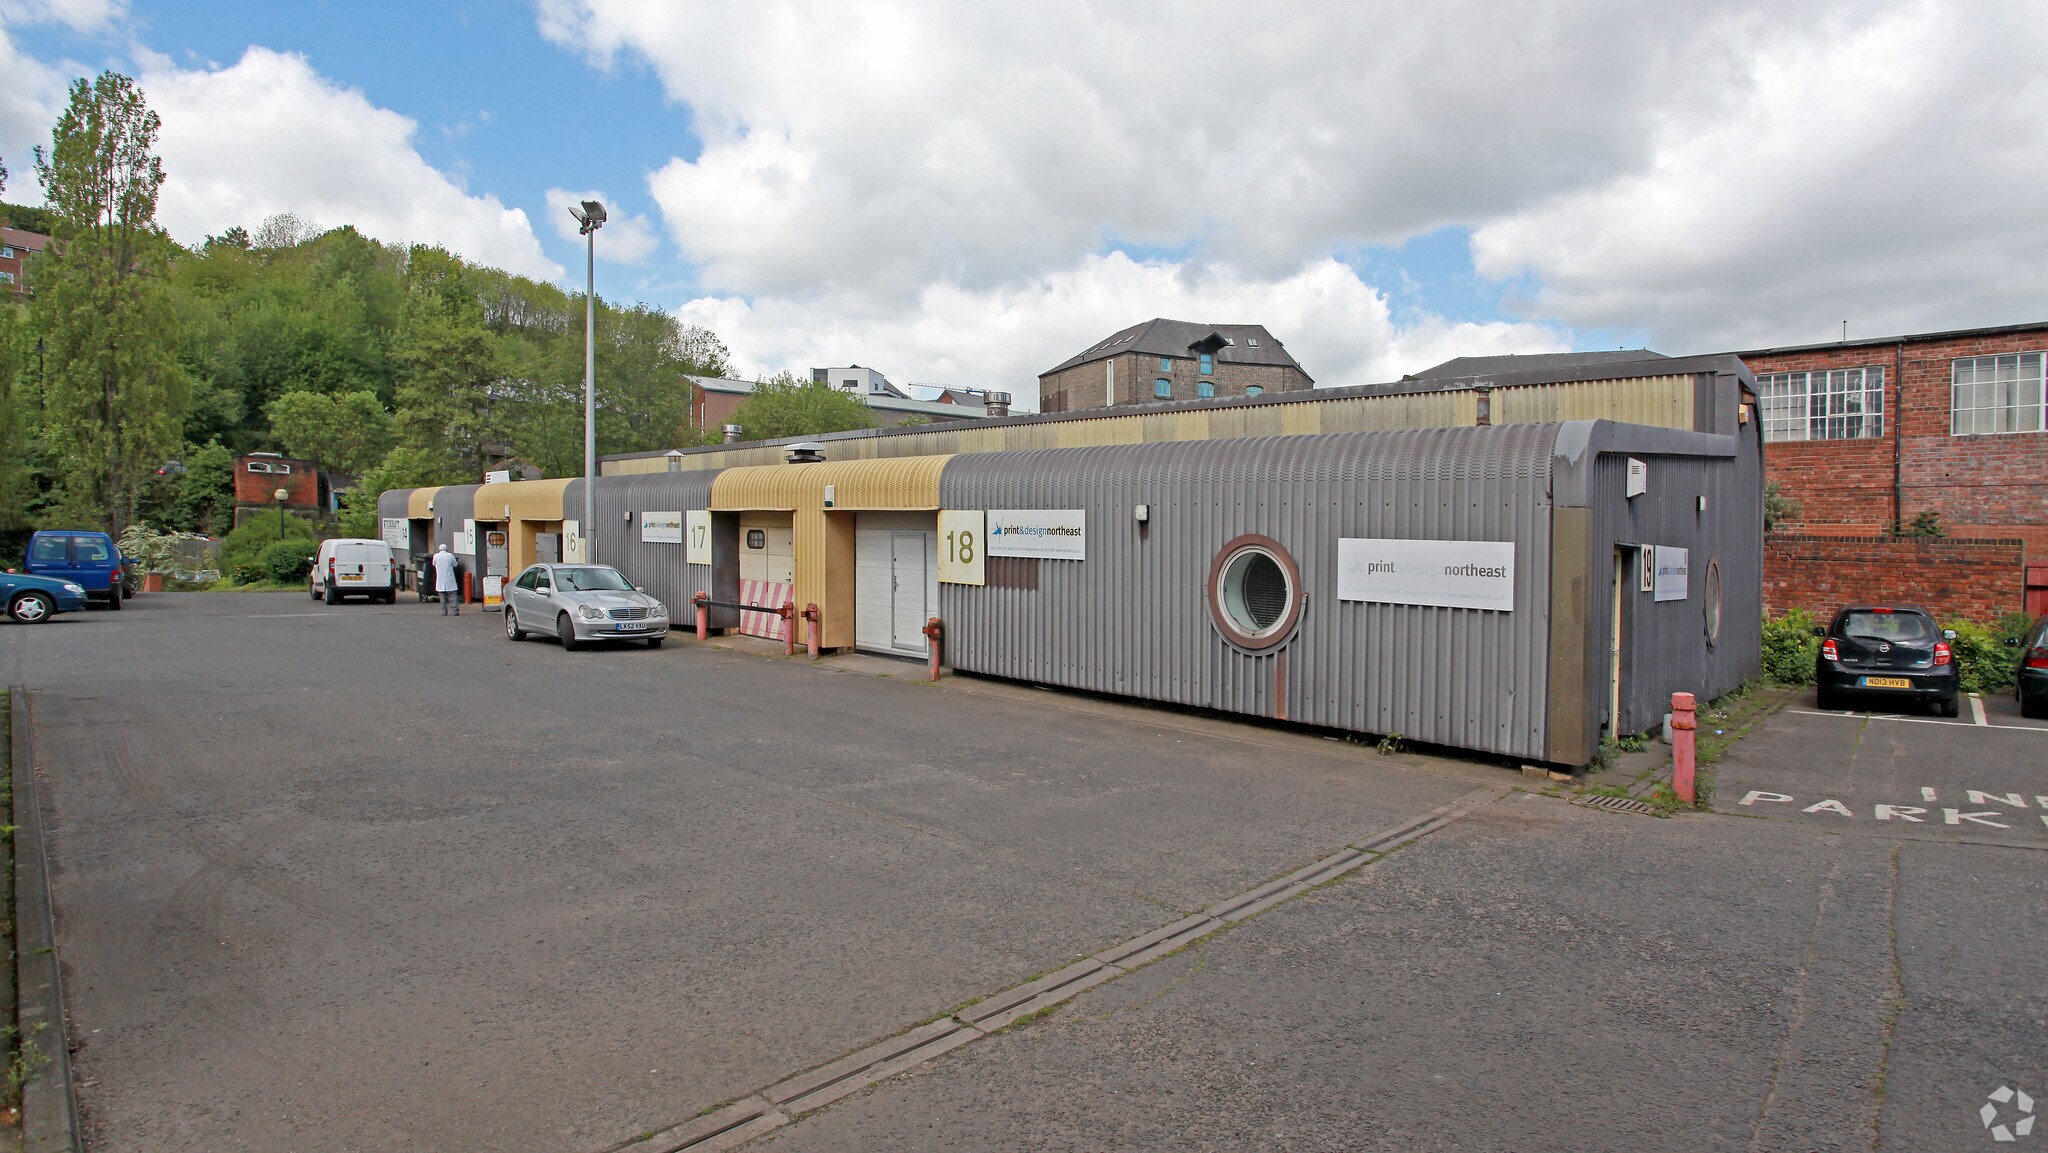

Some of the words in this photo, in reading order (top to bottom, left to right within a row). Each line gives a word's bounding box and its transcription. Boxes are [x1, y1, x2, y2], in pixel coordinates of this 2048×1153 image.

[466, 529, 474, 545] 15
[566, 532, 576, 552] 16
[692, 525, 706, 549] 17
[1003, 525, 1082, 538] print&designnortheast
[946, 530, 974, 564] 18
[1643, 548, 1652, 588] 19
